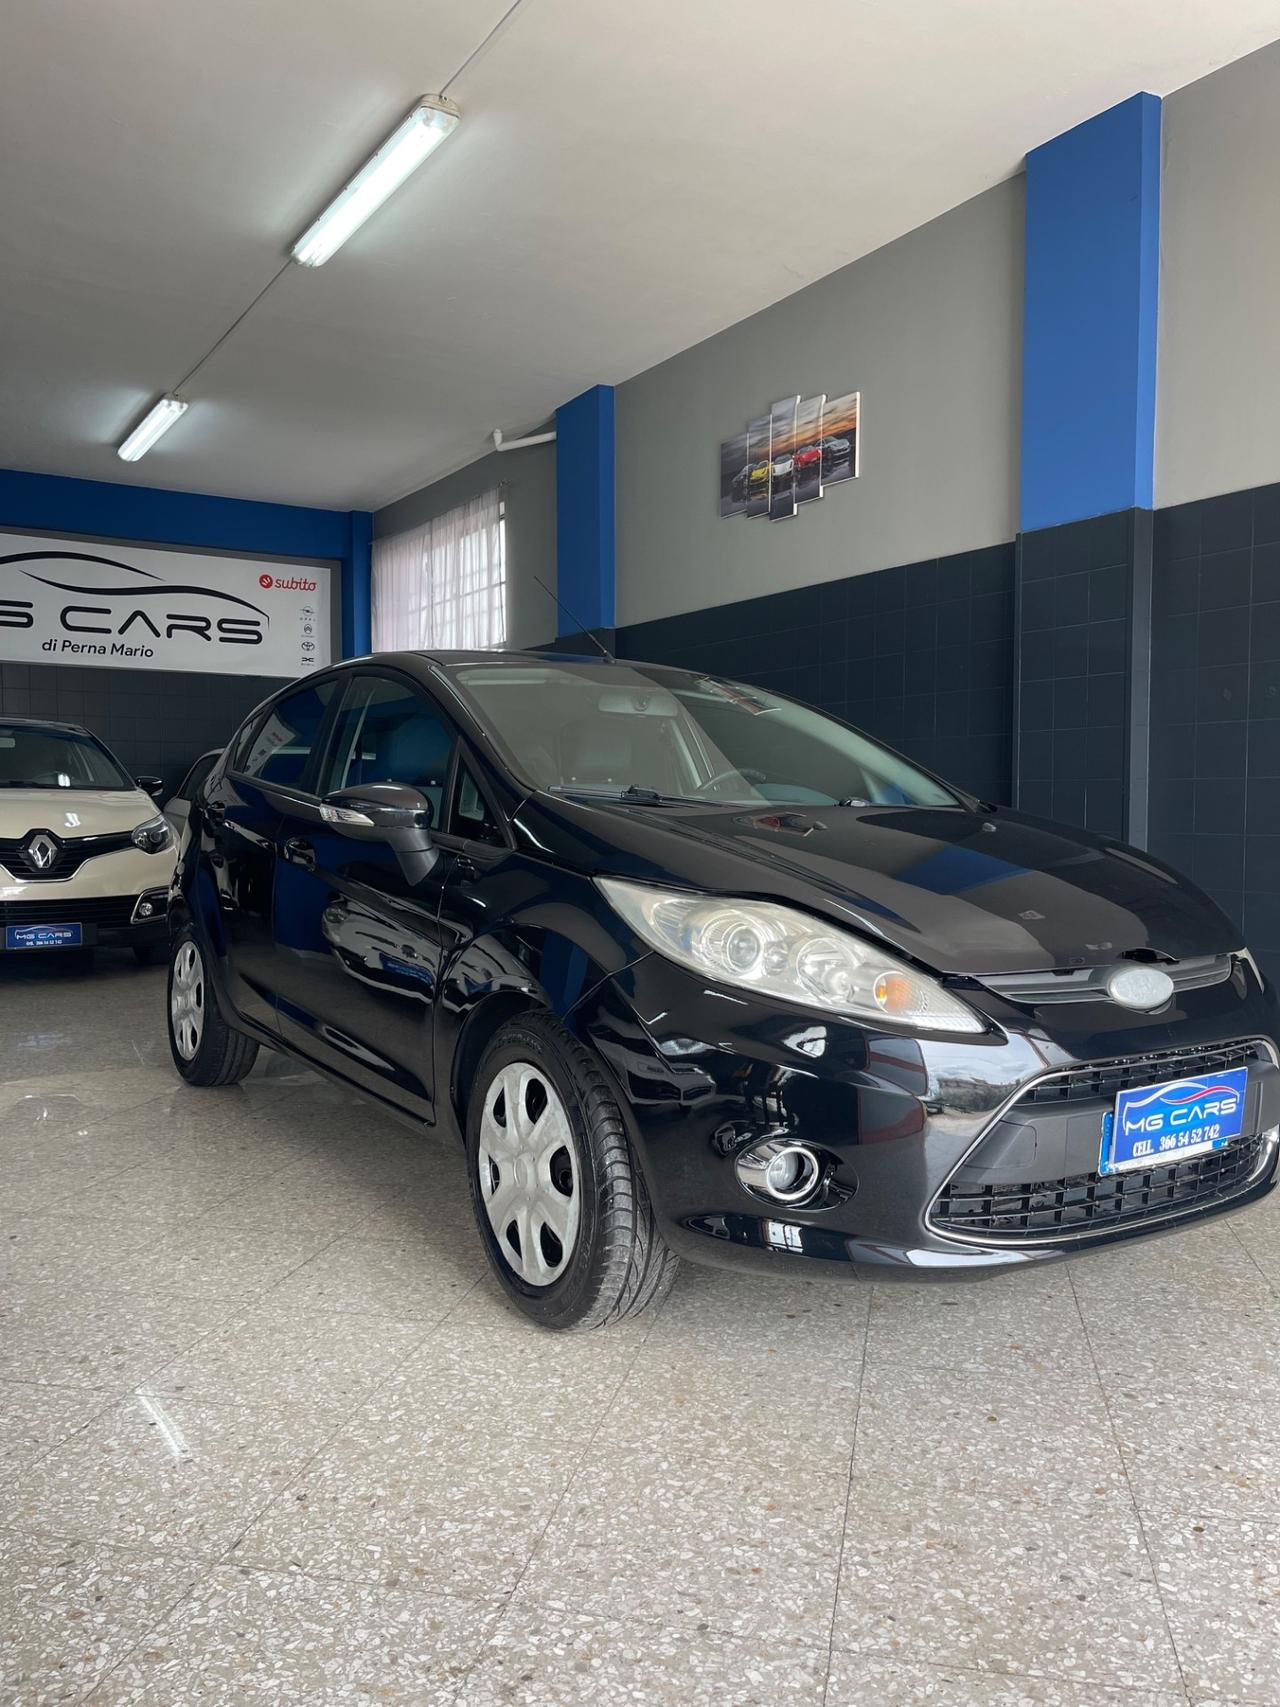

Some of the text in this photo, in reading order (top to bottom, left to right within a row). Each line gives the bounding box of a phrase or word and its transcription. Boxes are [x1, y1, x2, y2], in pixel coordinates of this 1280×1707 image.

[274, 577, 318, 592] subito
[60, 606, 263, 645] CARS
[42, 639, 154, 658] di Perna Mario
[1126, 1098, 1236, 1136] MG CARS
[1159, 1134, 1177, 1151] 366
[1178, 1130, 1189, 1146] 54
[1190, 1127, 1203, 1144] 52
[1204, 1124, 1220, 1140] 742
